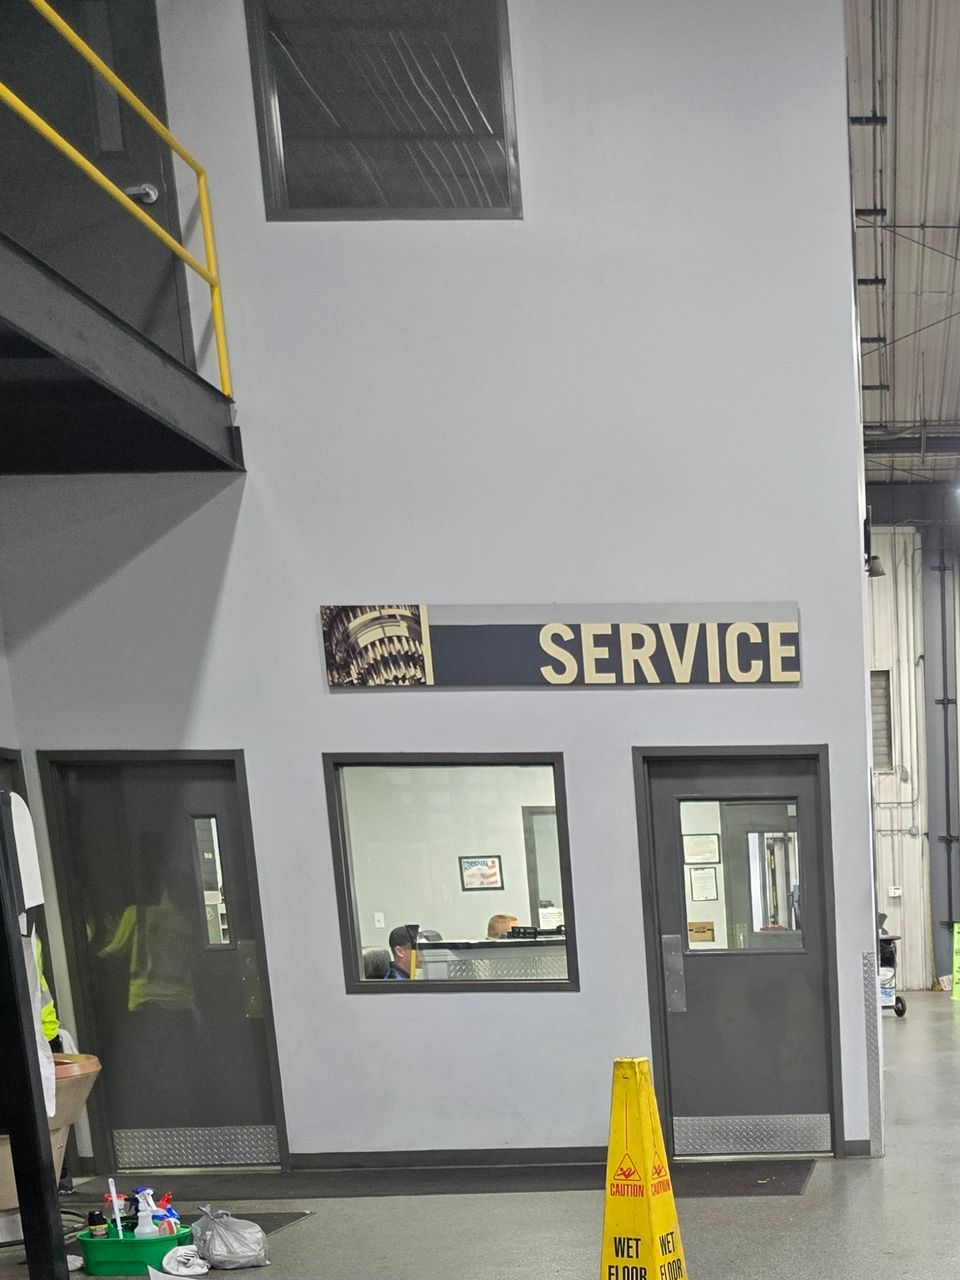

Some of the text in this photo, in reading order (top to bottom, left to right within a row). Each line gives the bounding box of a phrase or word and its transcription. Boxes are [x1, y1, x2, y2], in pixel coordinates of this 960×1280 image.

[539, 621, 801, 685] SERVICE
[610, 1183, 644, 1198] CAUTION
[651, 1180, 671, 1196] CAUTION
[614, 1236, 641, 1259] WET
[659, 1231, 676, 1256] WET
